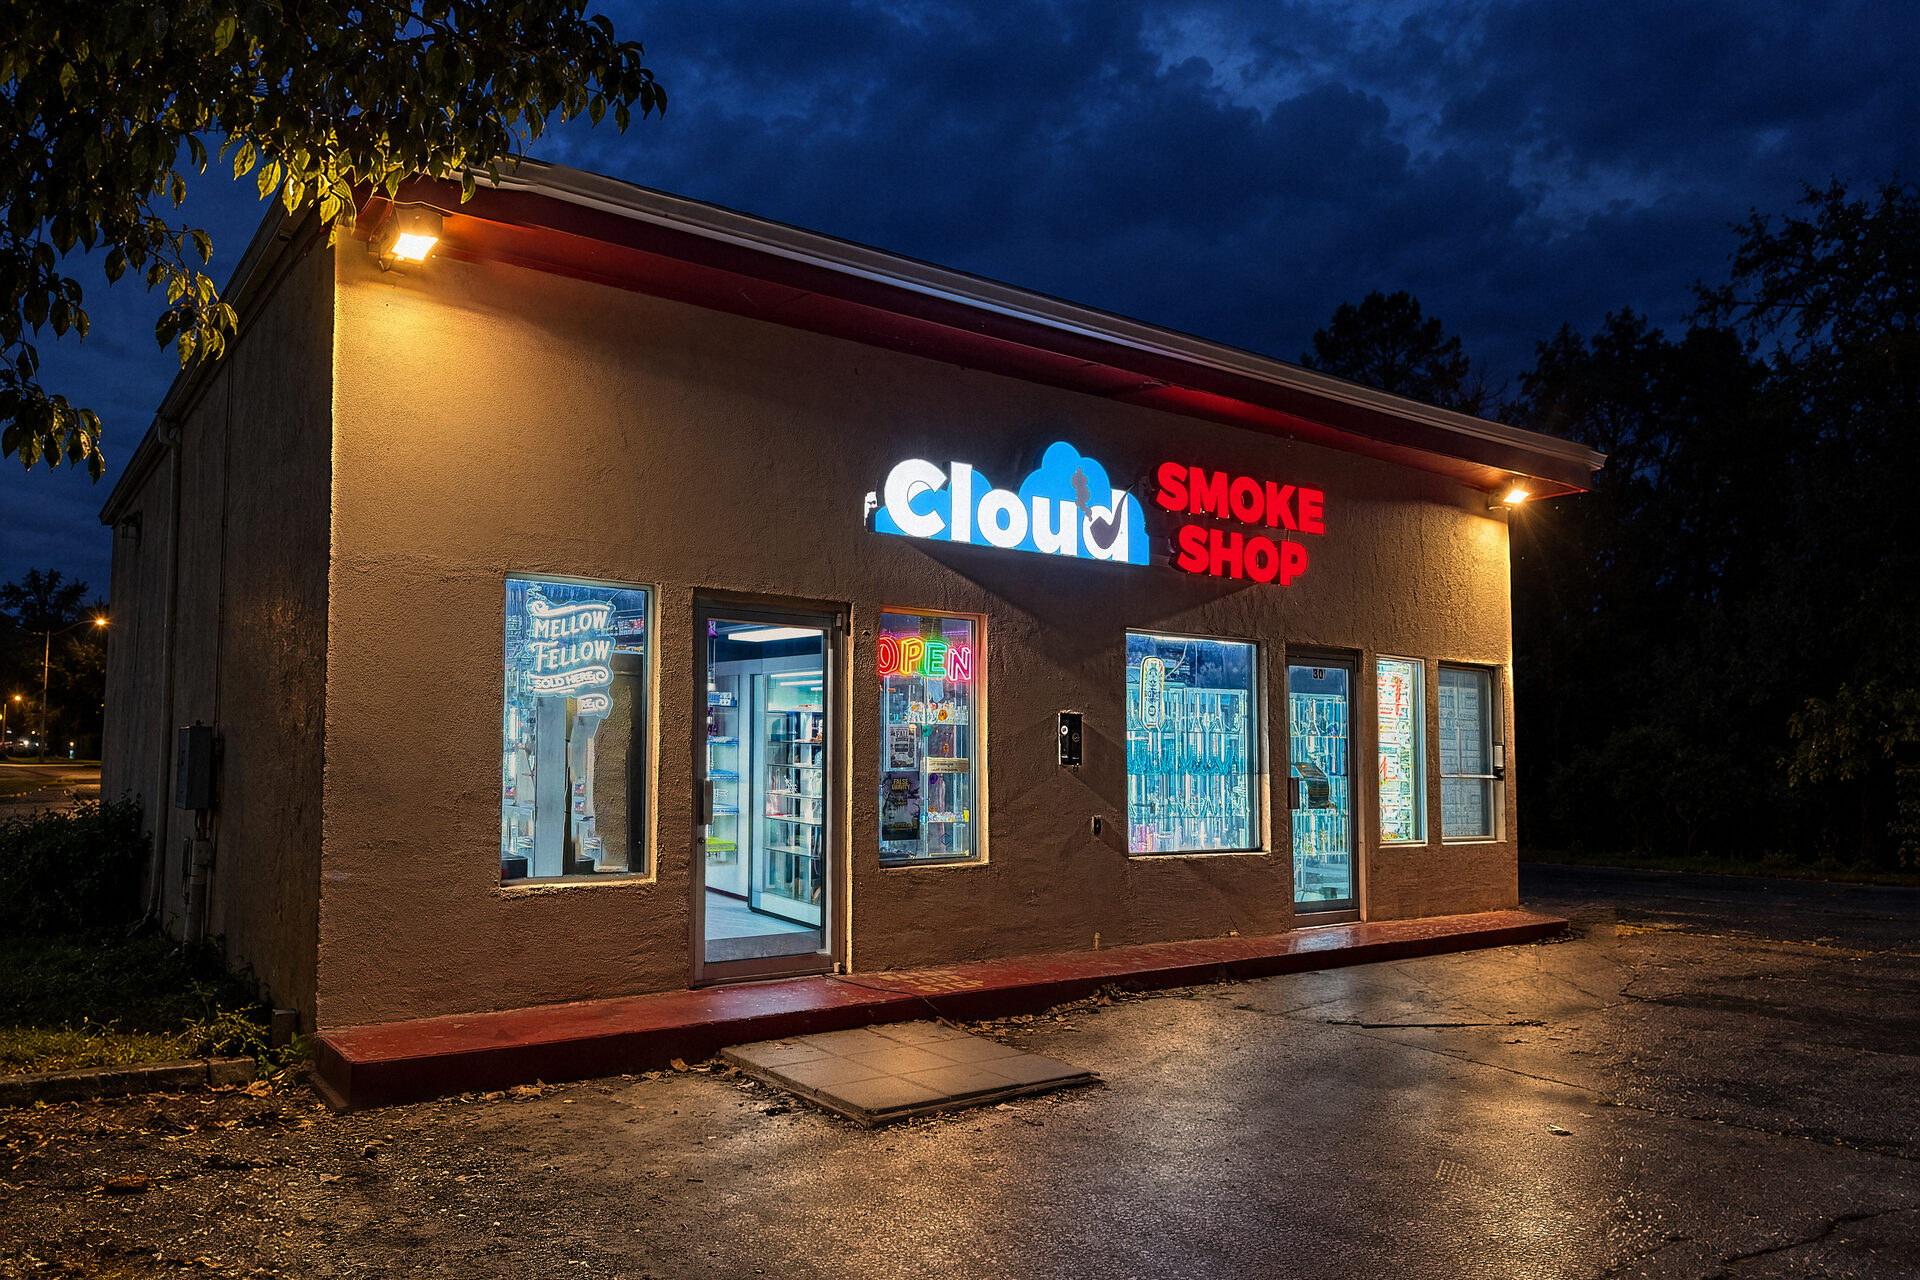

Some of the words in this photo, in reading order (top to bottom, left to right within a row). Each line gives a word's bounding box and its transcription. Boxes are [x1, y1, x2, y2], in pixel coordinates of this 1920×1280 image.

[883, 458, 1129, 562] Cloud
[1156, 461, 1326, 535] SMOKE
[1177, 524, 1308, 586] SHOP
[534, 610, 608, 639] MELLOW
[530, 640, 611, 672] FELLOW
[879, 636, 972, 682] OPEN
[534, 678, 565, 689] SOLD
[565, 670, 597, 686] HERE
